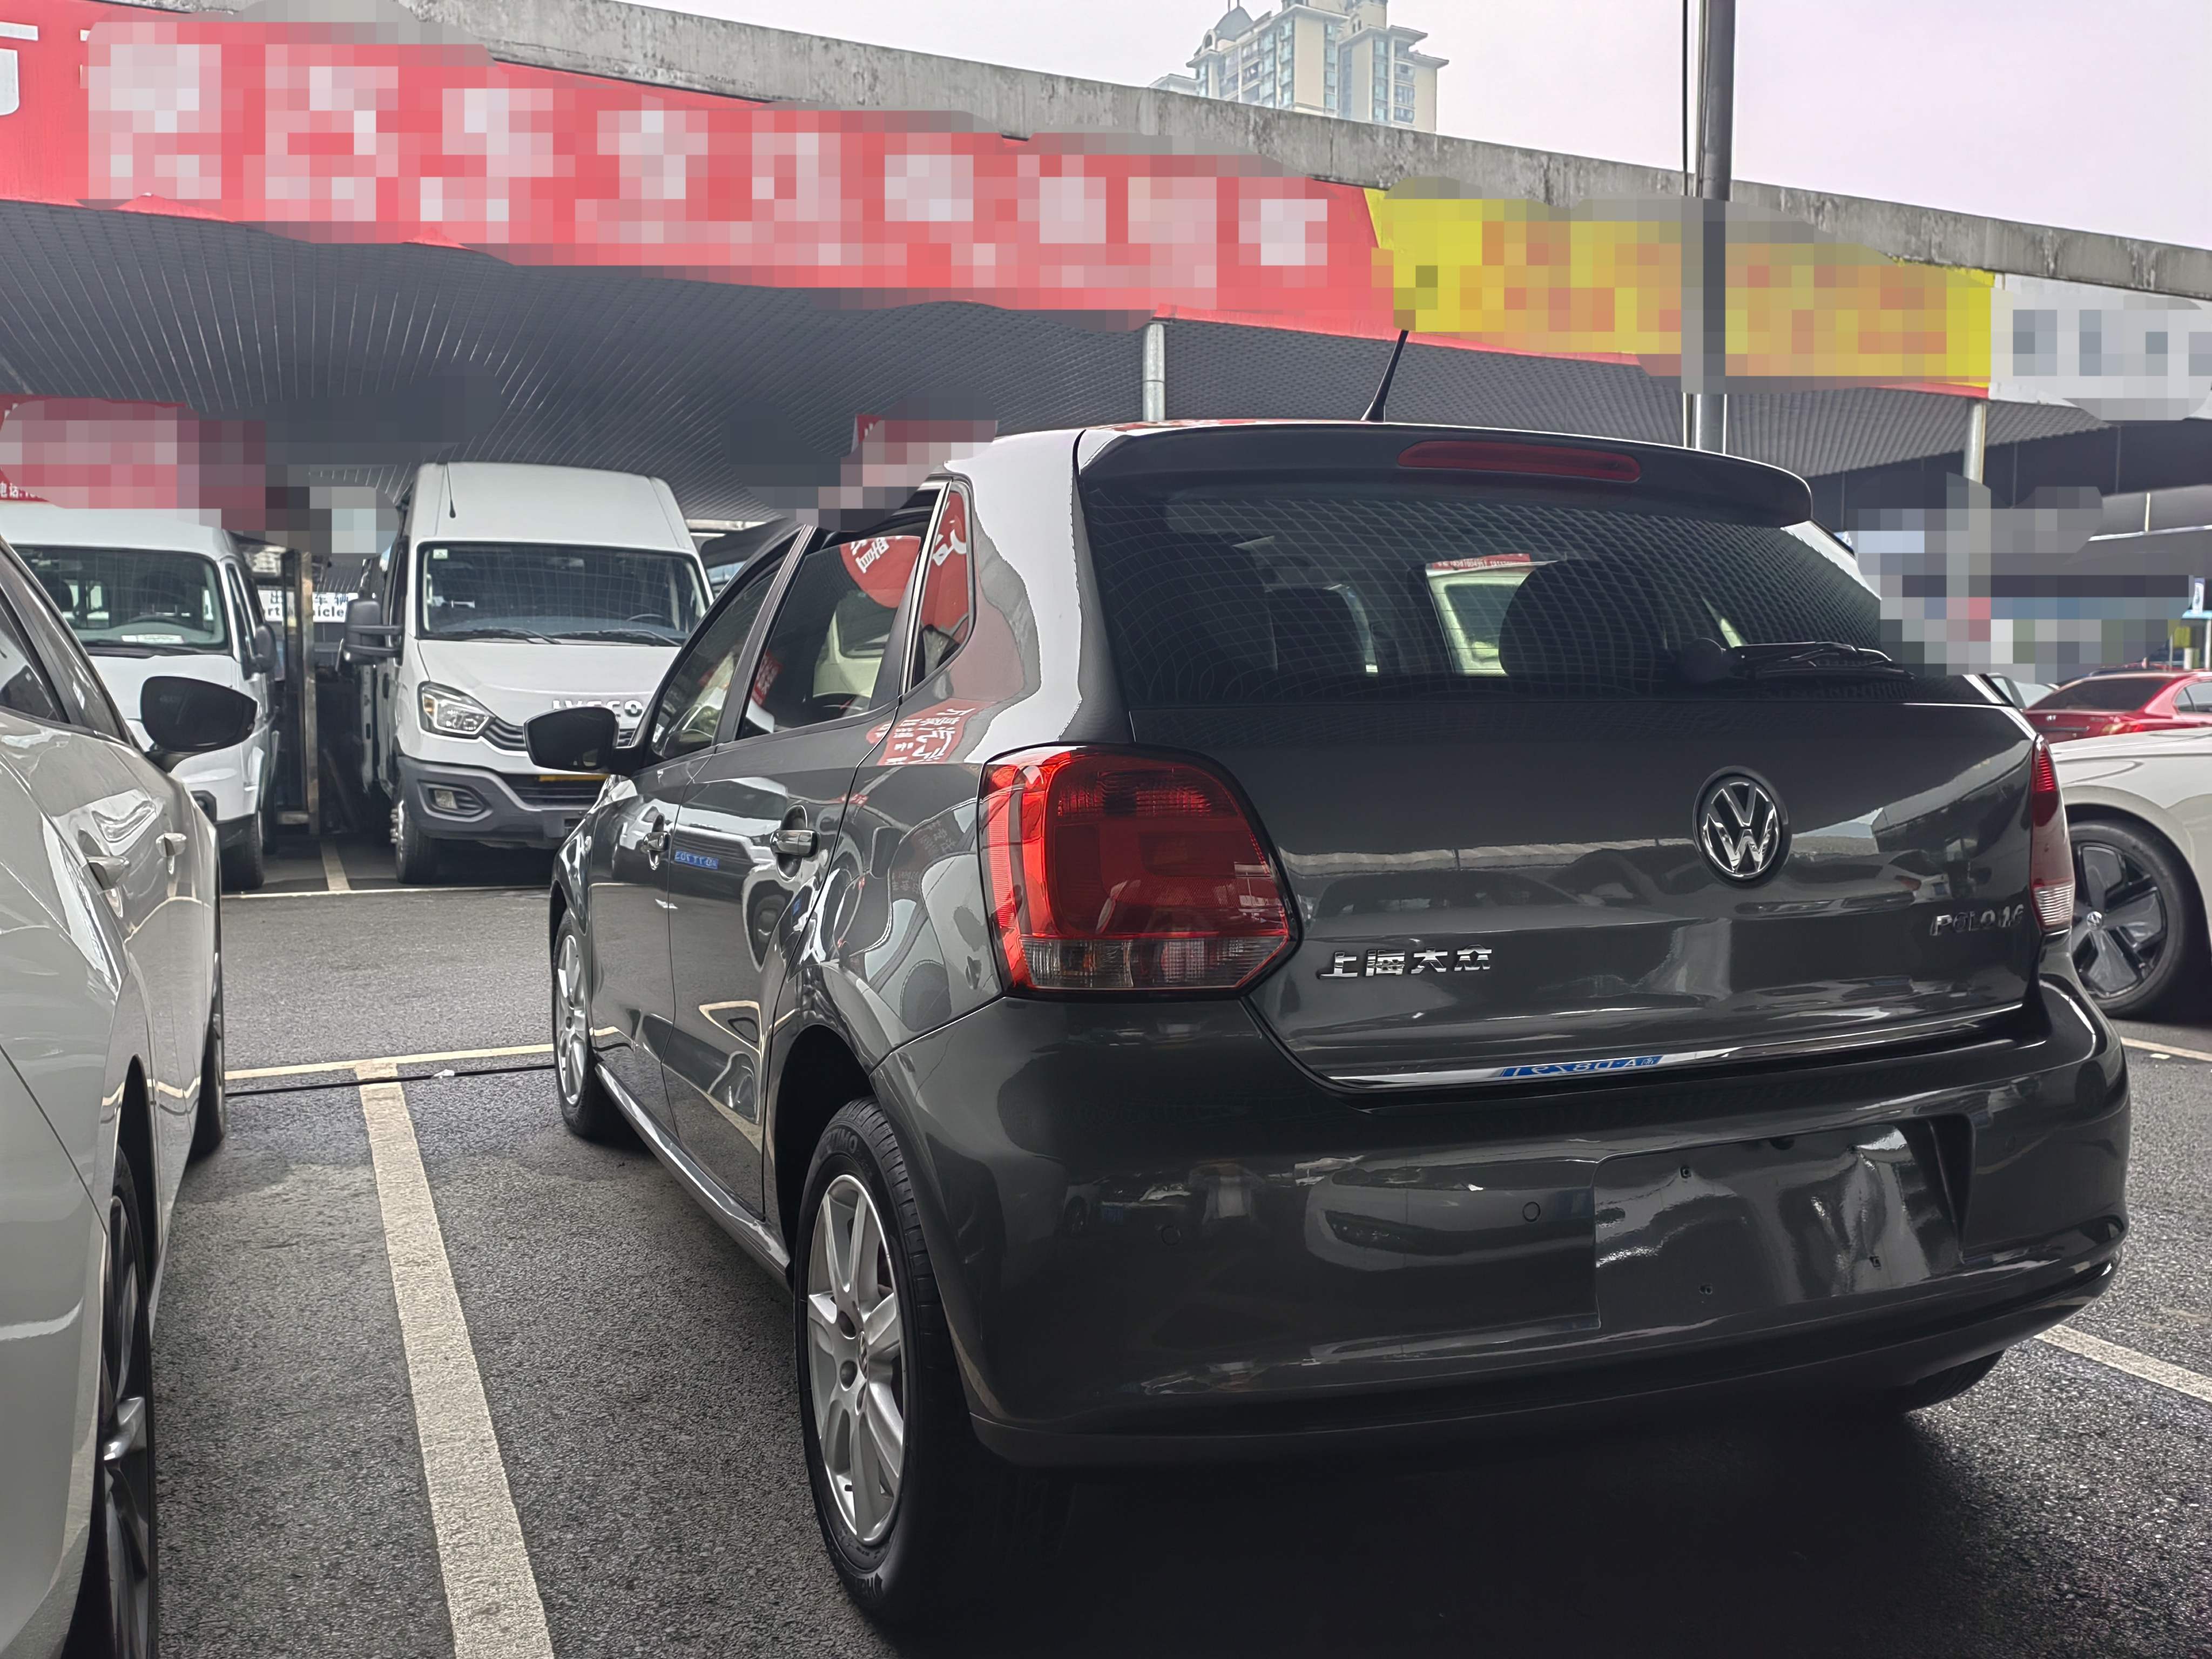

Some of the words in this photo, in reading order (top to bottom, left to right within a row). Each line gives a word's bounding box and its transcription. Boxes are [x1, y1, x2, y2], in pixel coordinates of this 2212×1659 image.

[1930, 909, 1996, 936] POLO
[1318, 944, 1493, 979] 上海大众
